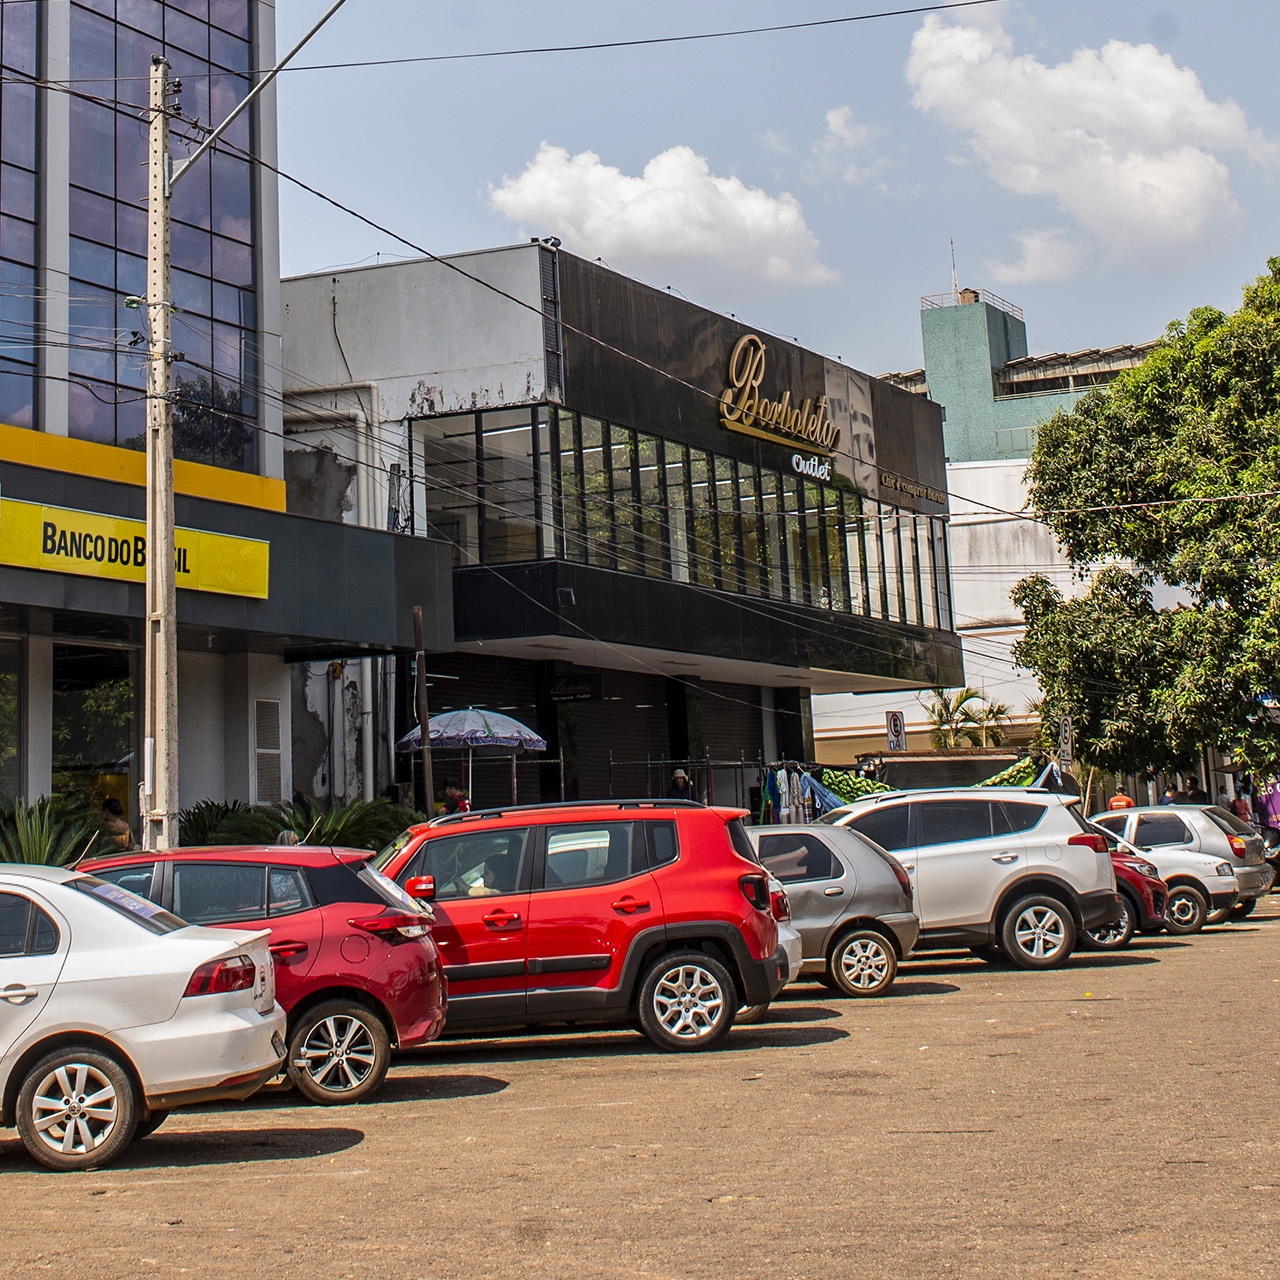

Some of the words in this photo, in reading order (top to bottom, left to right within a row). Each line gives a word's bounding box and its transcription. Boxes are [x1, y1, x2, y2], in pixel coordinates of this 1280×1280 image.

[791, 454, 832, 481] Outlet
[42, 522, 106, 563] BANCO
[107, 537, 131, 566] DO
[133, 536, 190, 574] BIL
